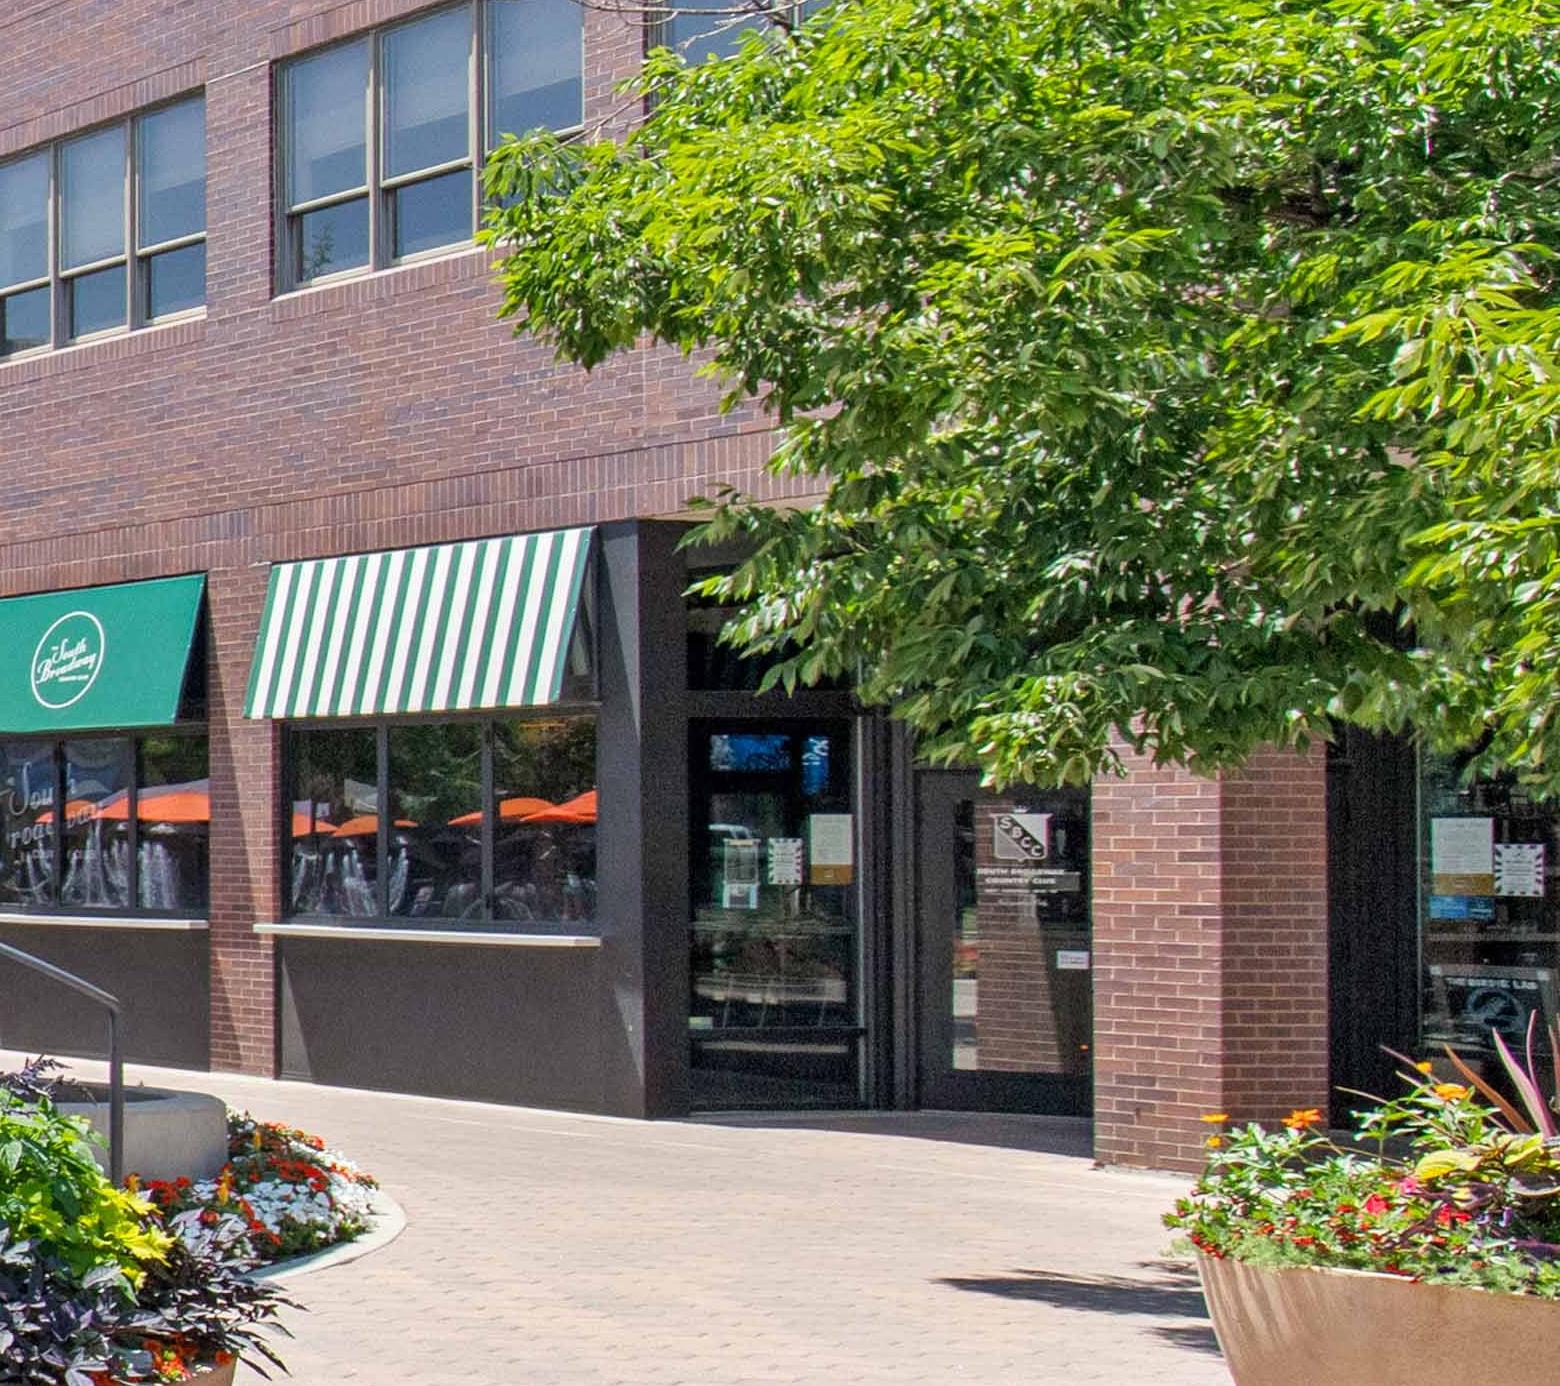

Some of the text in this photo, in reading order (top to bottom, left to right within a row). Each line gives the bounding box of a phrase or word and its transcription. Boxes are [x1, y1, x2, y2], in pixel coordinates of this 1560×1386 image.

[52, 637, 88, 664] South
[36, 653, 97, 684] Broadway
[999, 816, 1043, 857] SBCC
